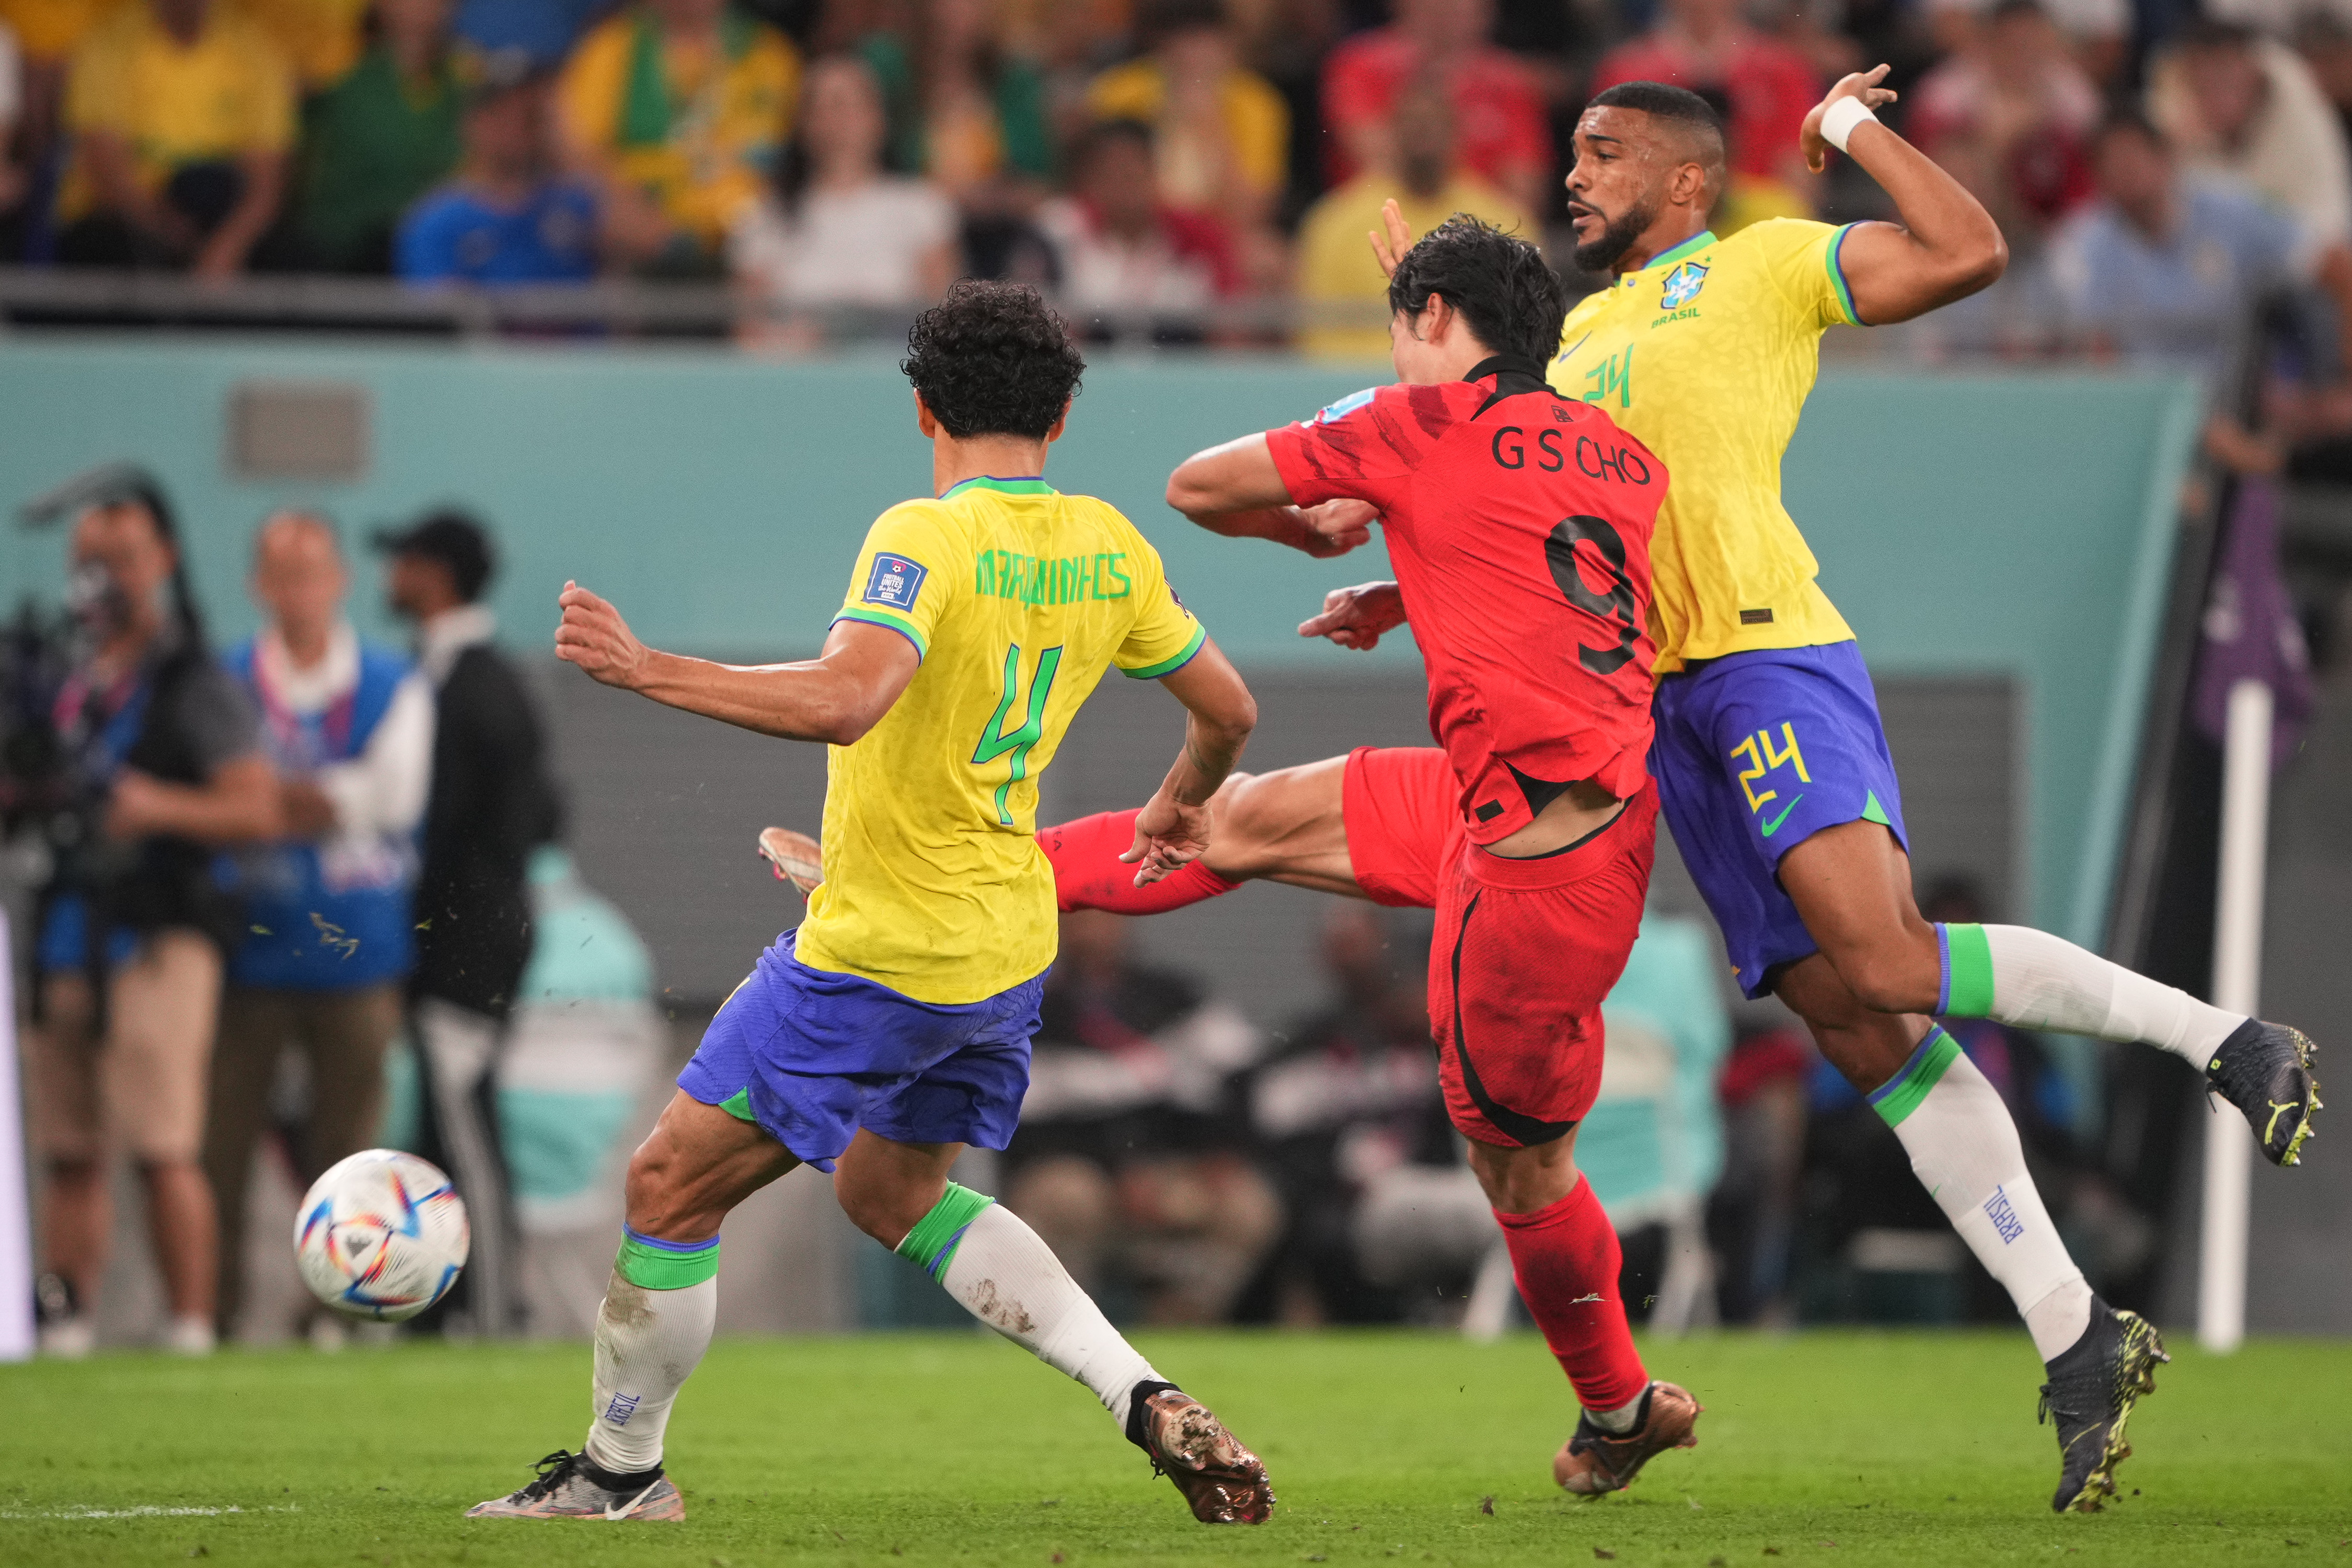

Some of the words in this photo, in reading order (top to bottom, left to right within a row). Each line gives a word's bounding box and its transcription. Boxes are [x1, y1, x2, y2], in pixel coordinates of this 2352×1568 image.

[1652, 308, 1701, 329] BRASIL
[1583, 343, 1634, 407] 24
[1492, 426, 1525, 469] G
[1538, 429, 1564, 472] S
[1576, 435, 1651, 485] CHO
[881, 578, 903, 589] UNITES
[1544, 515, 1641, 675] 9
[971, 643, 1064, 825] 4
[1730, 721, 1812, 814] 24
[1984, 1184, 2024, 1245] BRASIL
